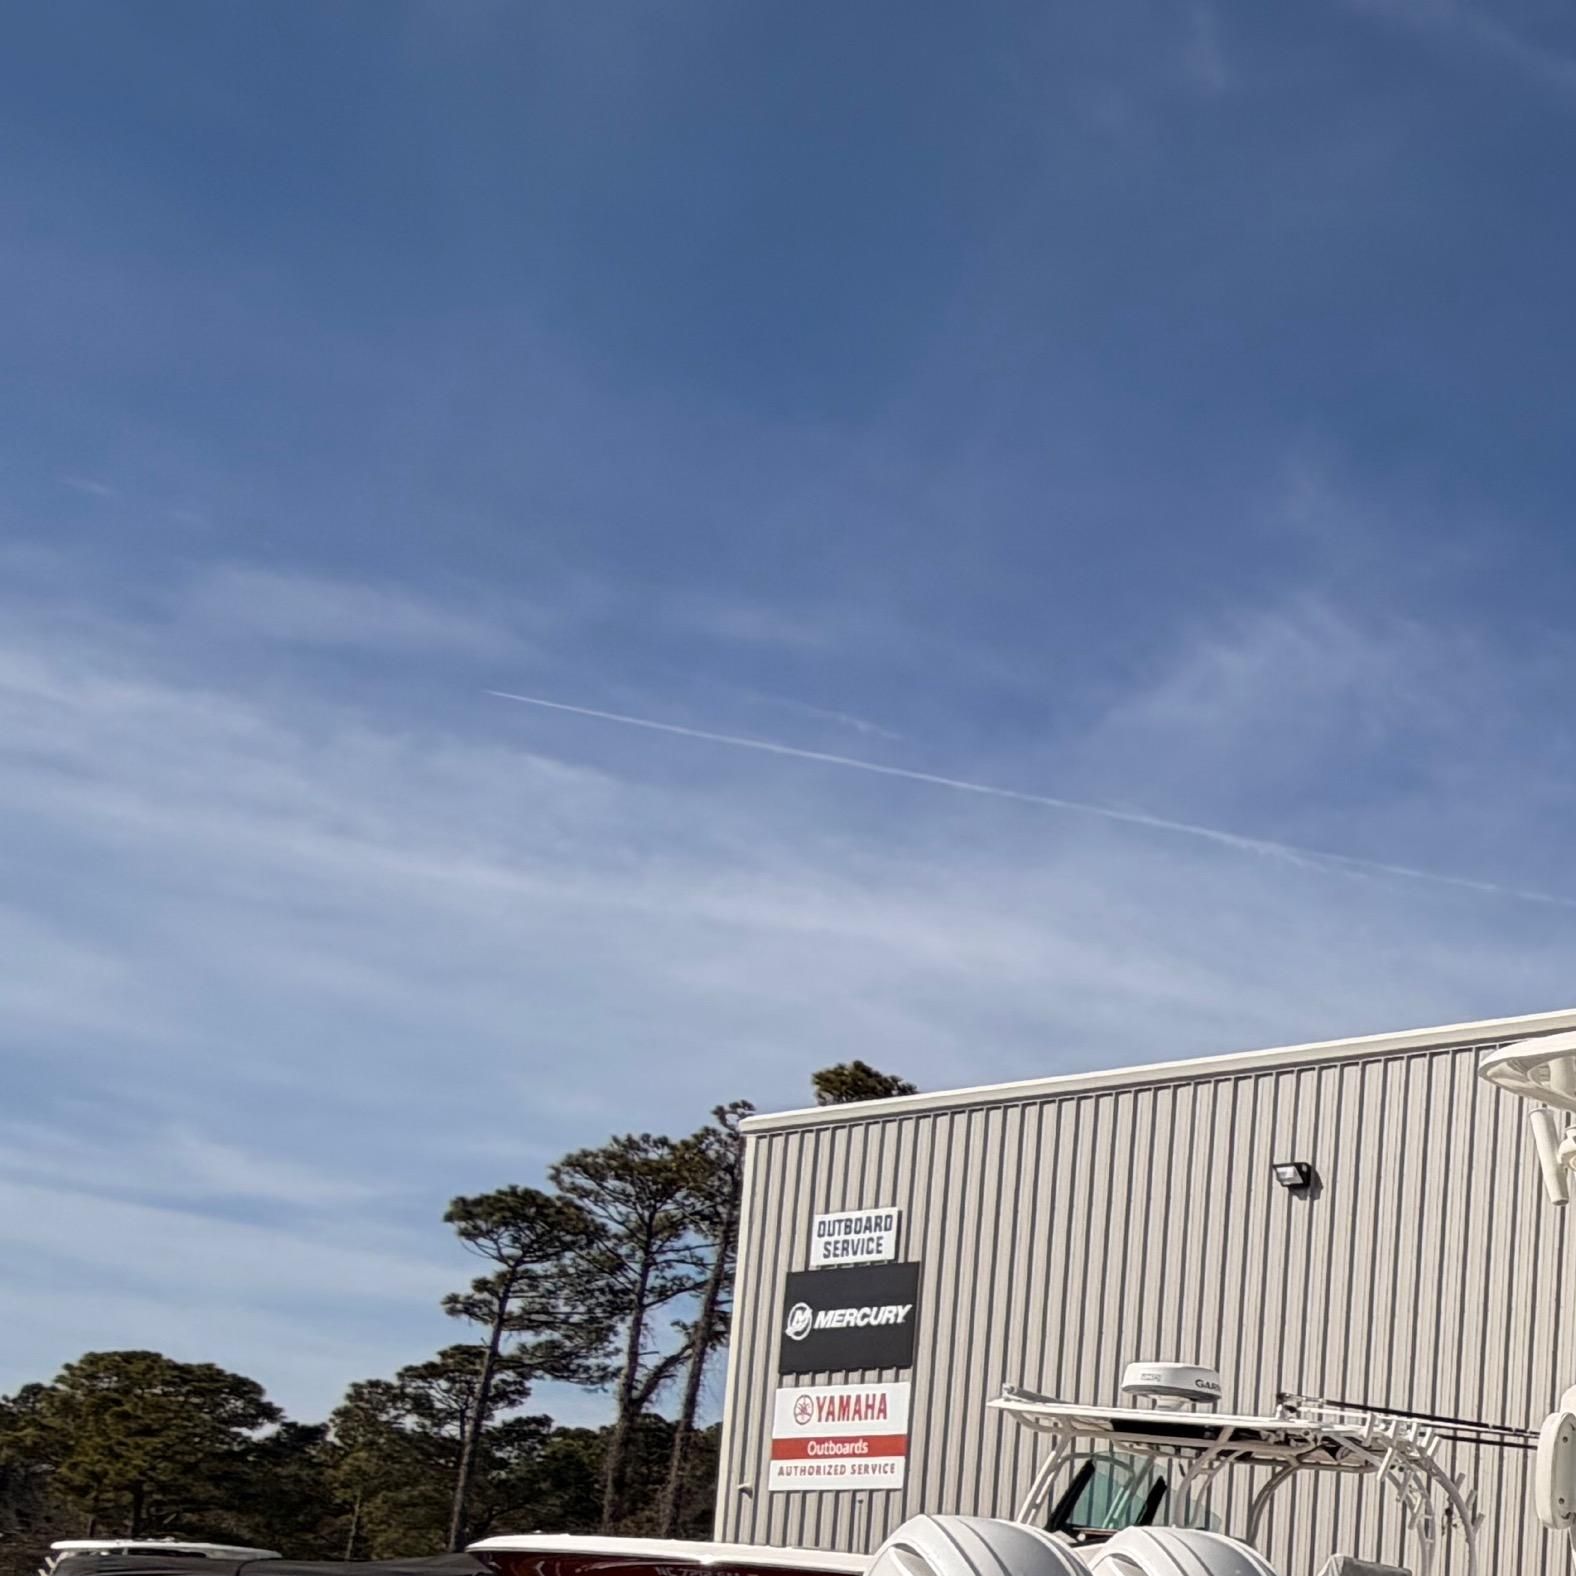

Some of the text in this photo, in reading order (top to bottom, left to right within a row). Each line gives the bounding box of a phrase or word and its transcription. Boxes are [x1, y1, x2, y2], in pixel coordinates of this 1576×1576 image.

[817, 1214, 893, 1238] OUTBOARD
[822, 1236, 884, 1259] SERVICE
[813, 1304, 913, 1329] MERCURY
[815, 1393, 888, 1423] YAMAHA
[807, 1440, 869, 1456] Outboards
[777, 1462, 896, 1477] AUTHORIZED SERVICE
